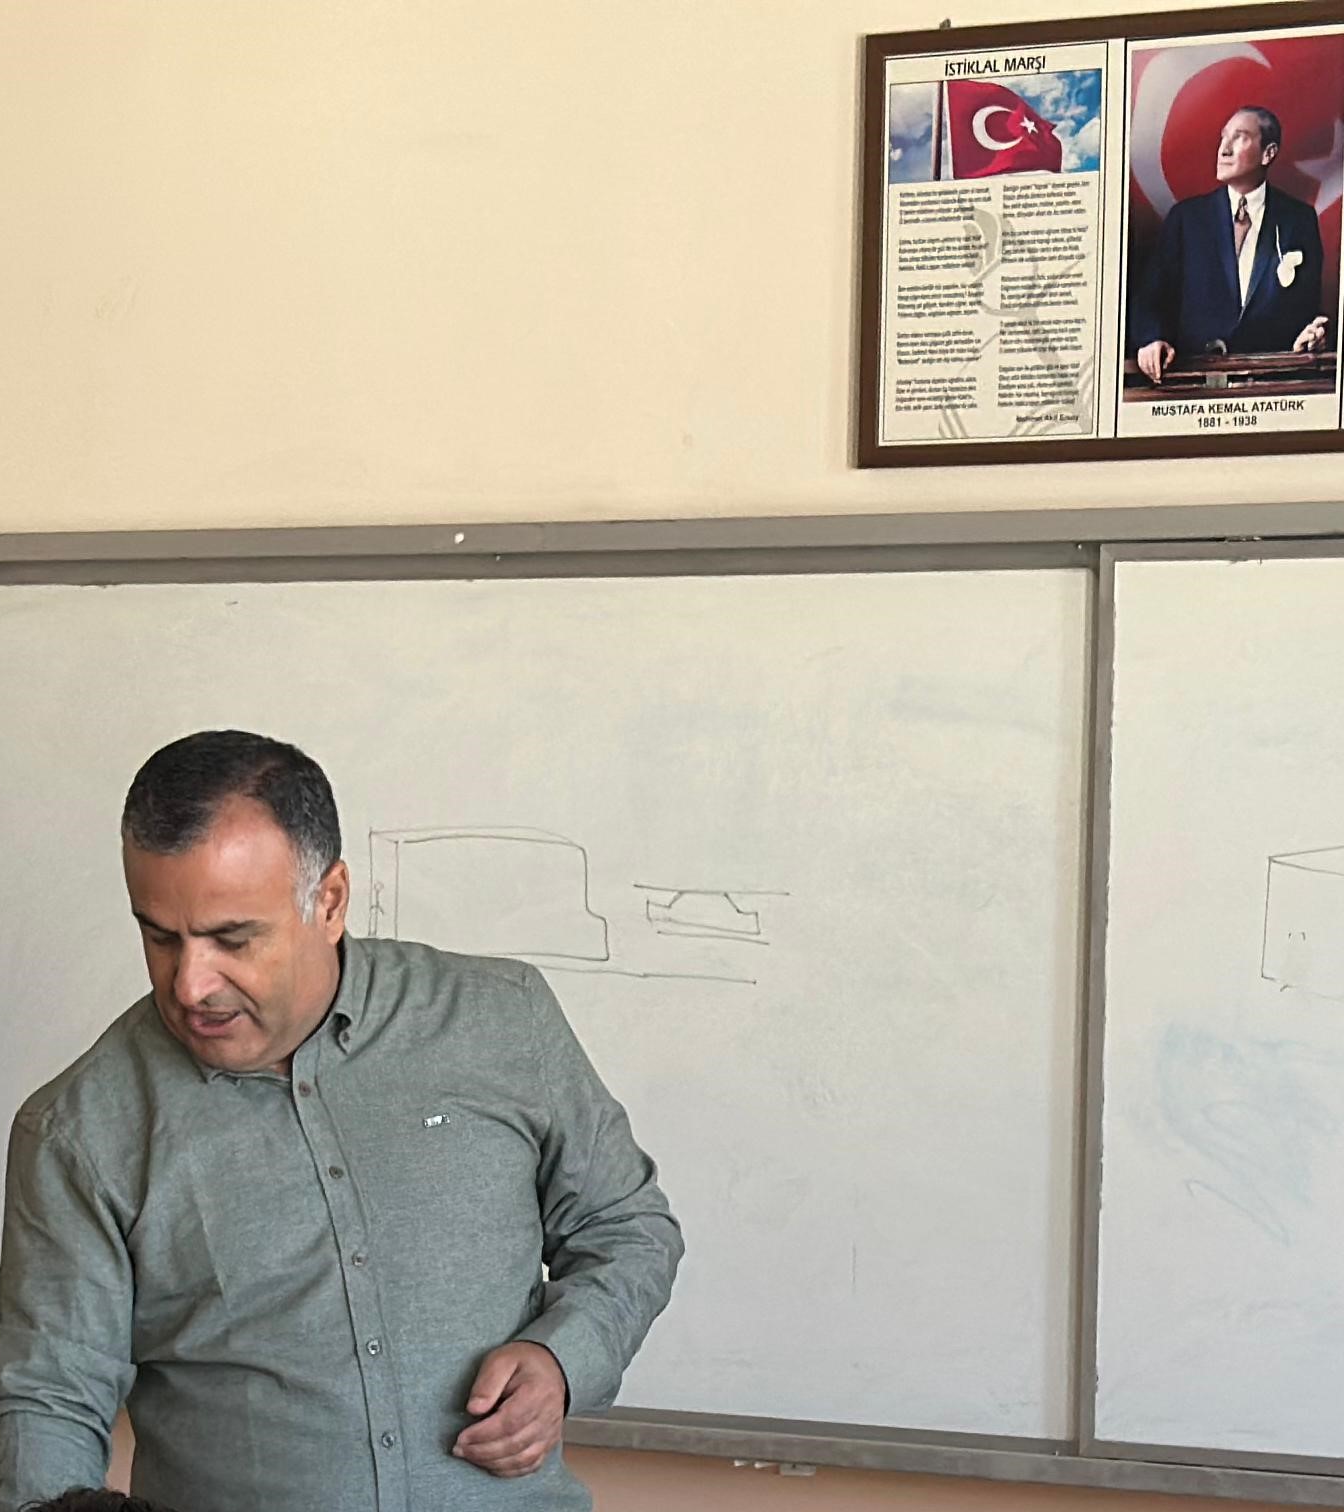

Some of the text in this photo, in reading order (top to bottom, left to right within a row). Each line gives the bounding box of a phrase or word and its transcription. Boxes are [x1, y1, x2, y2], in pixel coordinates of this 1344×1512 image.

[944, 55, 1046, 75] İSTİKLAL MARŞI
[1152, 399, 1305, 417] MUSTAFA KEMAL ATATÜRK
[1197, 416, 1221, 429] 1881
[1231, 415, 1257, 427] 1938
